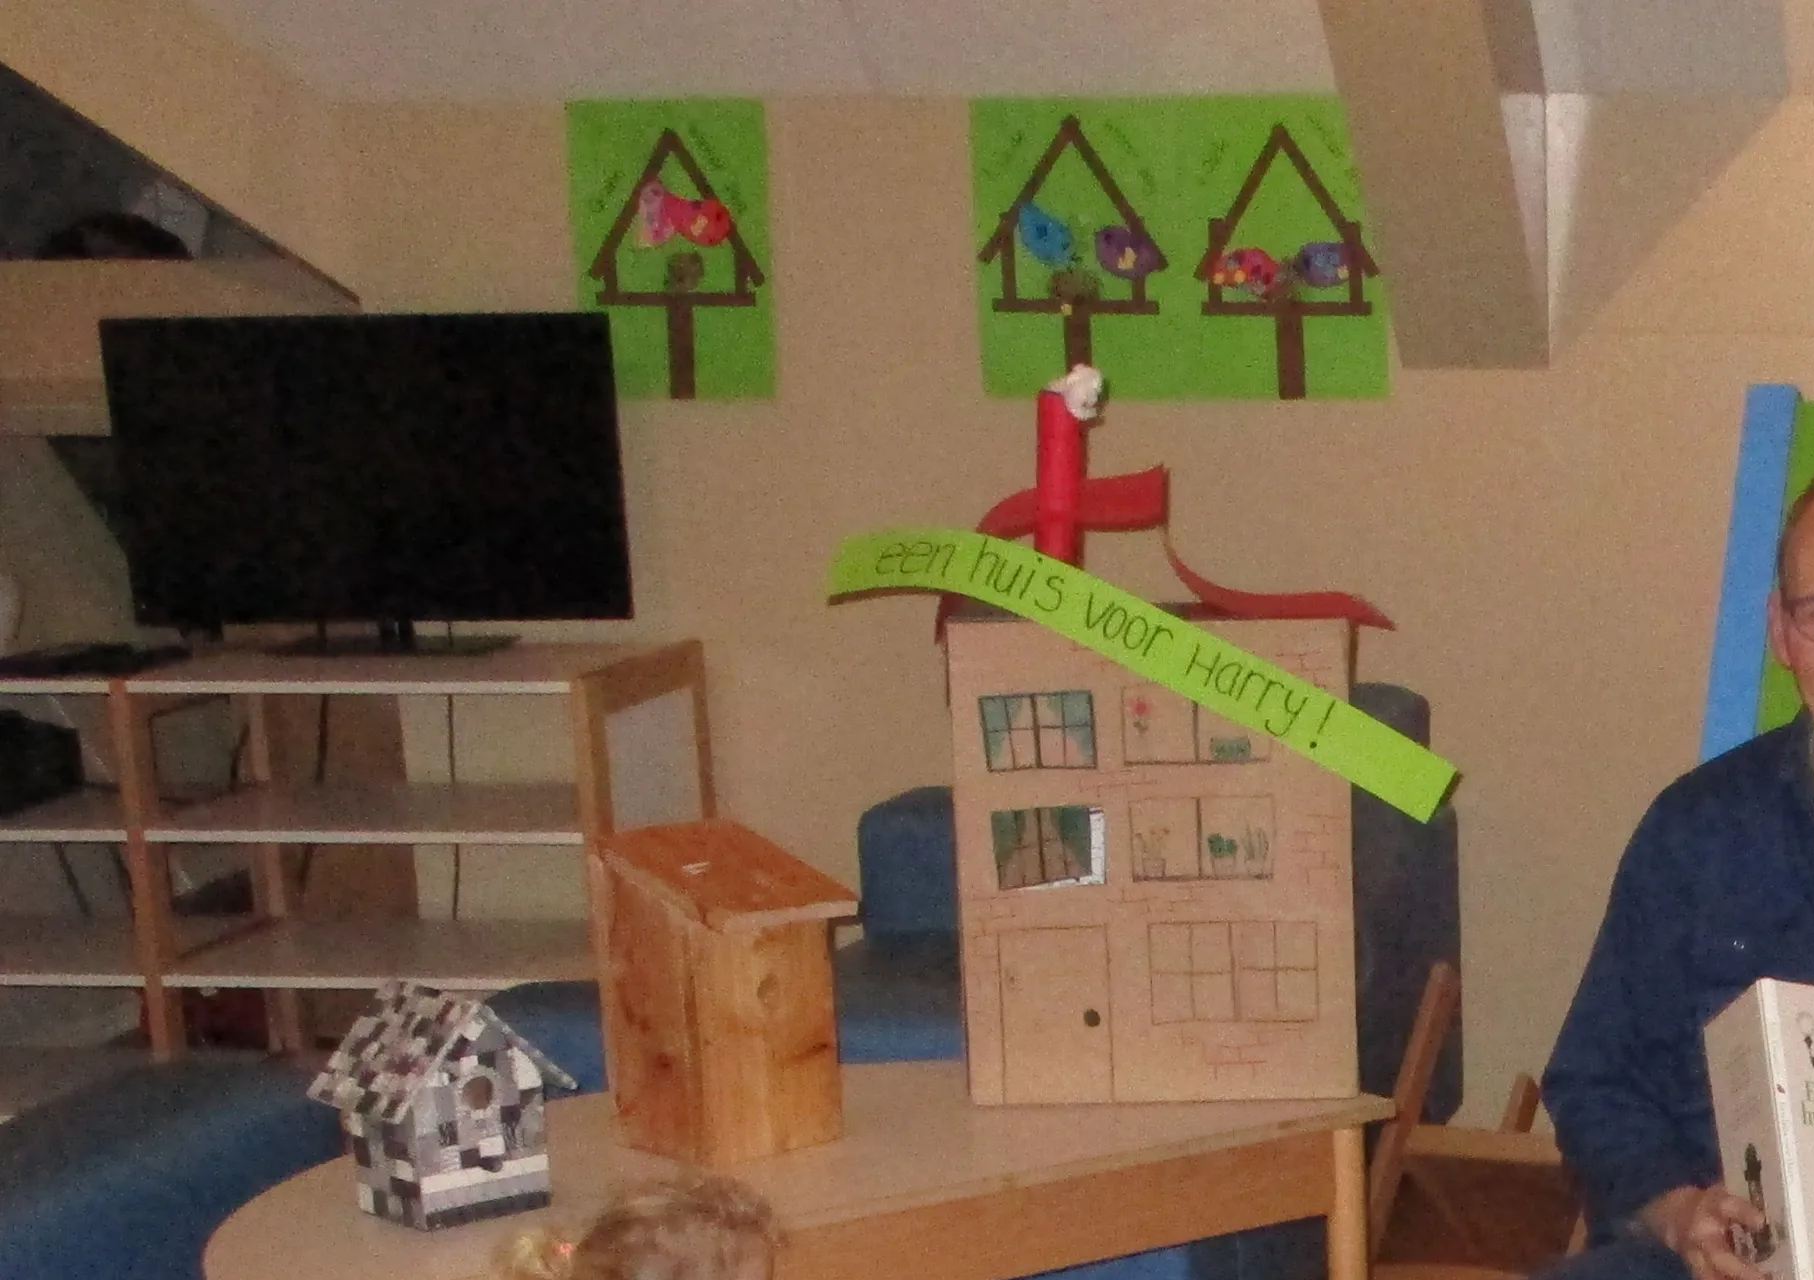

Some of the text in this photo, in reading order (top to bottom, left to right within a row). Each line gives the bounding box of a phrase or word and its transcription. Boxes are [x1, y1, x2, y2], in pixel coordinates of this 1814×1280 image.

[875, 536, 1337, 750] een huis voor Harry!
